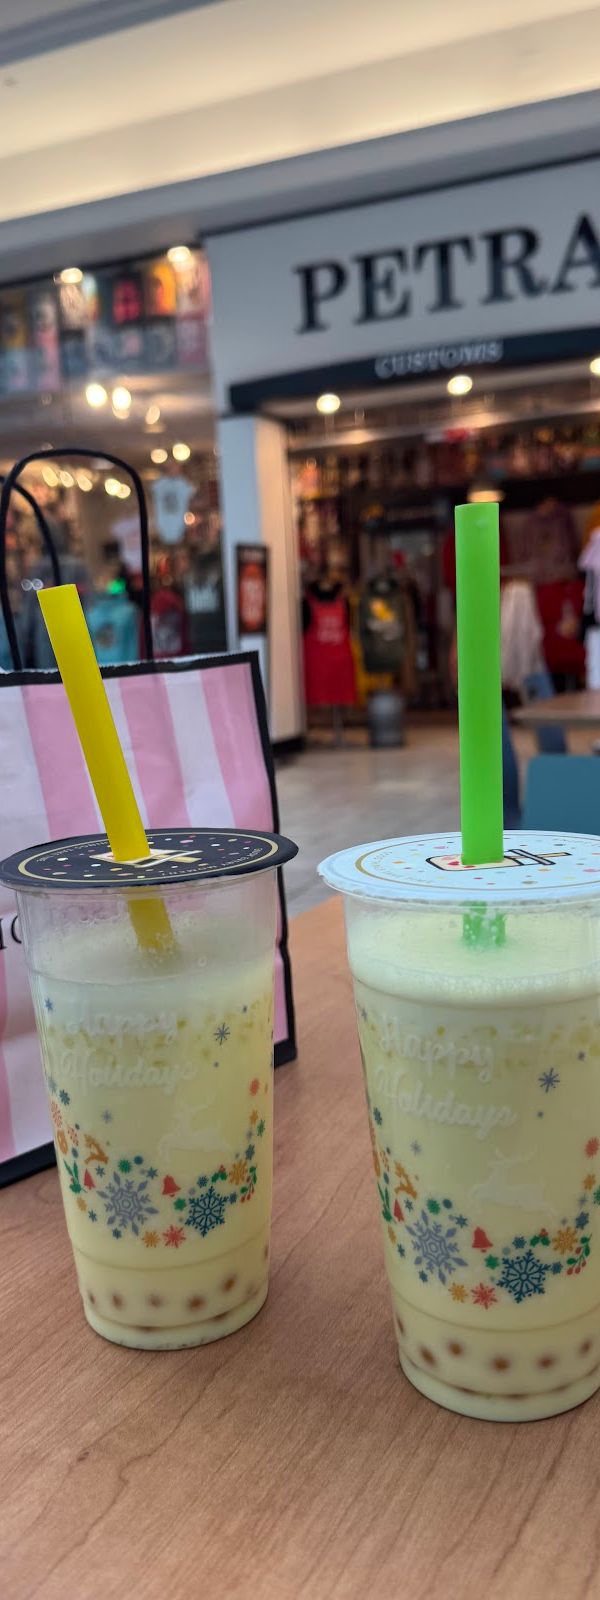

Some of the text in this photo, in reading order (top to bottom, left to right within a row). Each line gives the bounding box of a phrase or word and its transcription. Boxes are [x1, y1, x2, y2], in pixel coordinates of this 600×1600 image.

[292, 210, 600, 335] PETRA
[63, 1011, 177, 1048] Happy
[376, 1013, 494, 1083] Happy
[60, 1049, 199, 1097] Holidays
[375, 1066, 518, 1141] Holidays
